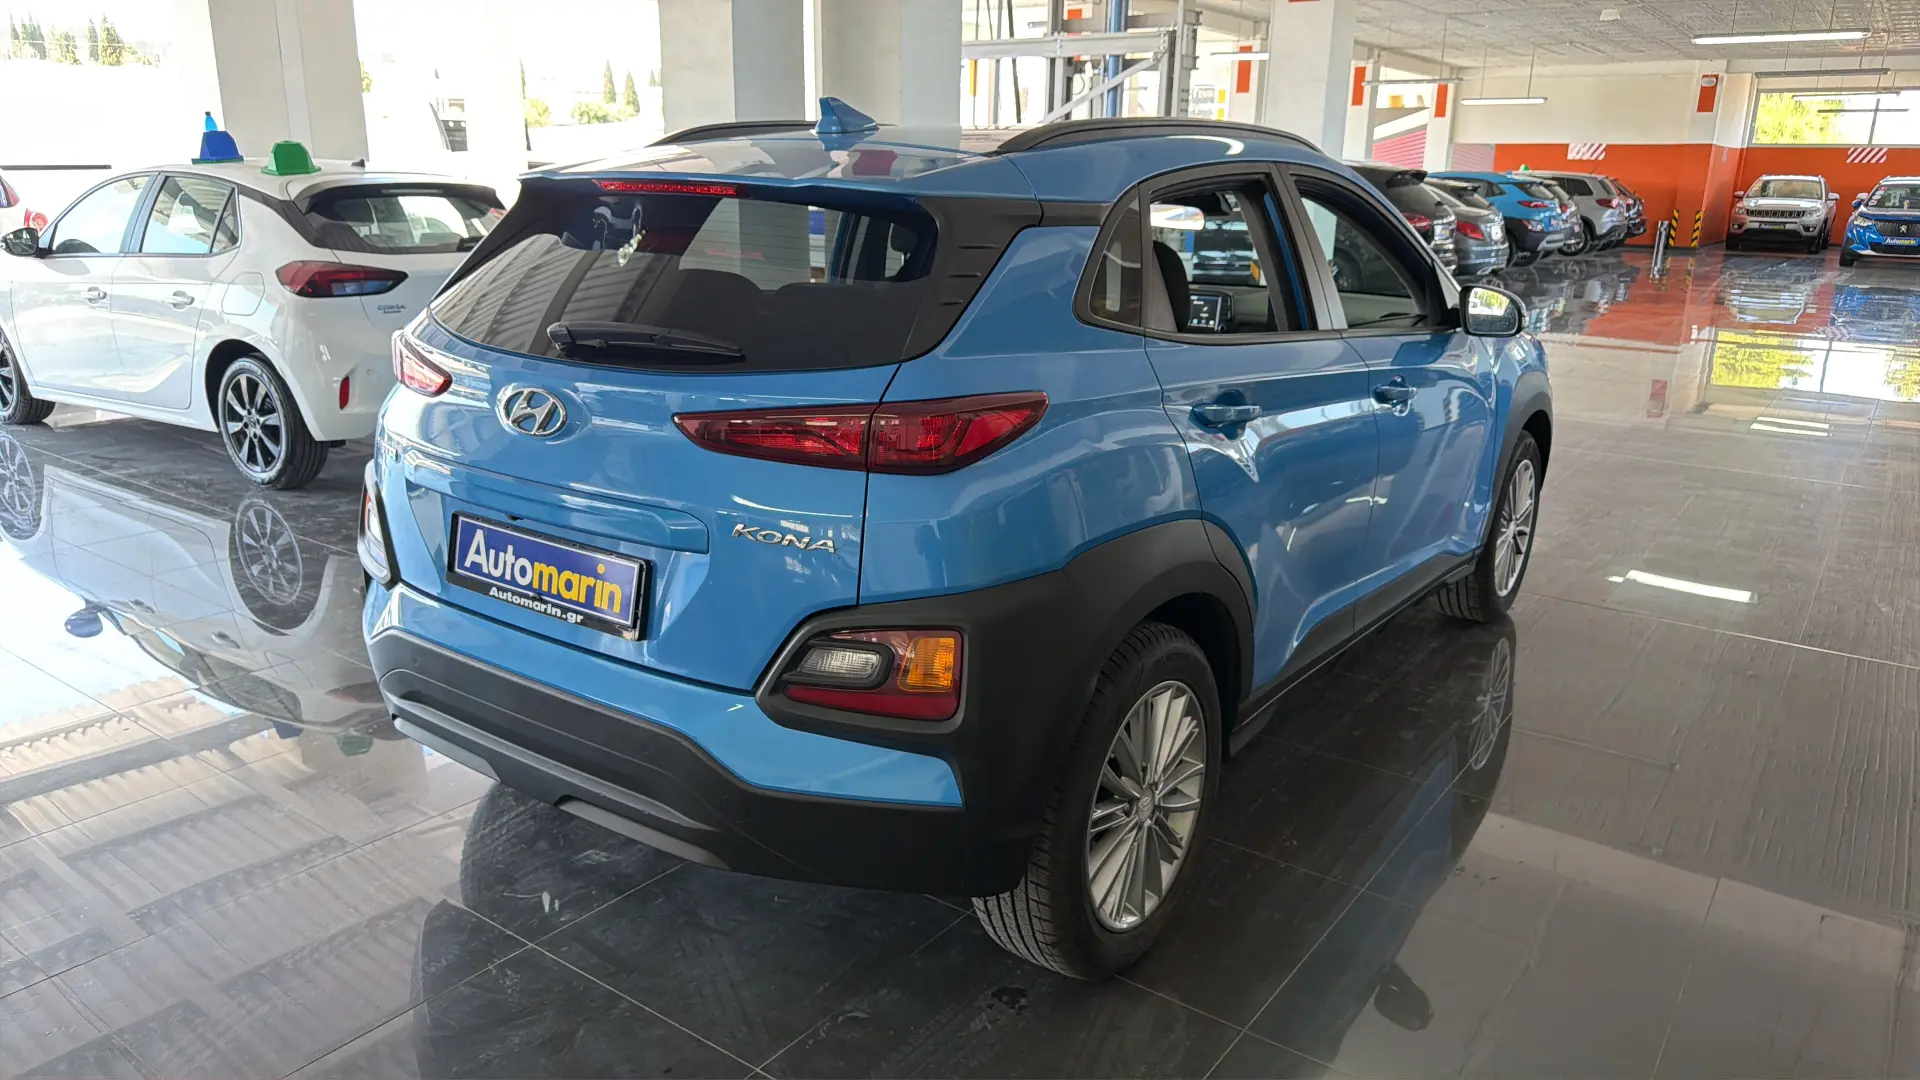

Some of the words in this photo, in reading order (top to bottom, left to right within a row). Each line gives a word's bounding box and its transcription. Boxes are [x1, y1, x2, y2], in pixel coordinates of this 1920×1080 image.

[1885, 237, 1916, 245] Automarin
[731, 523, 836, 554] KONA
[464, 528, 622, 614] Automarin
[488, 586, 584, 624] Automarin.gr
